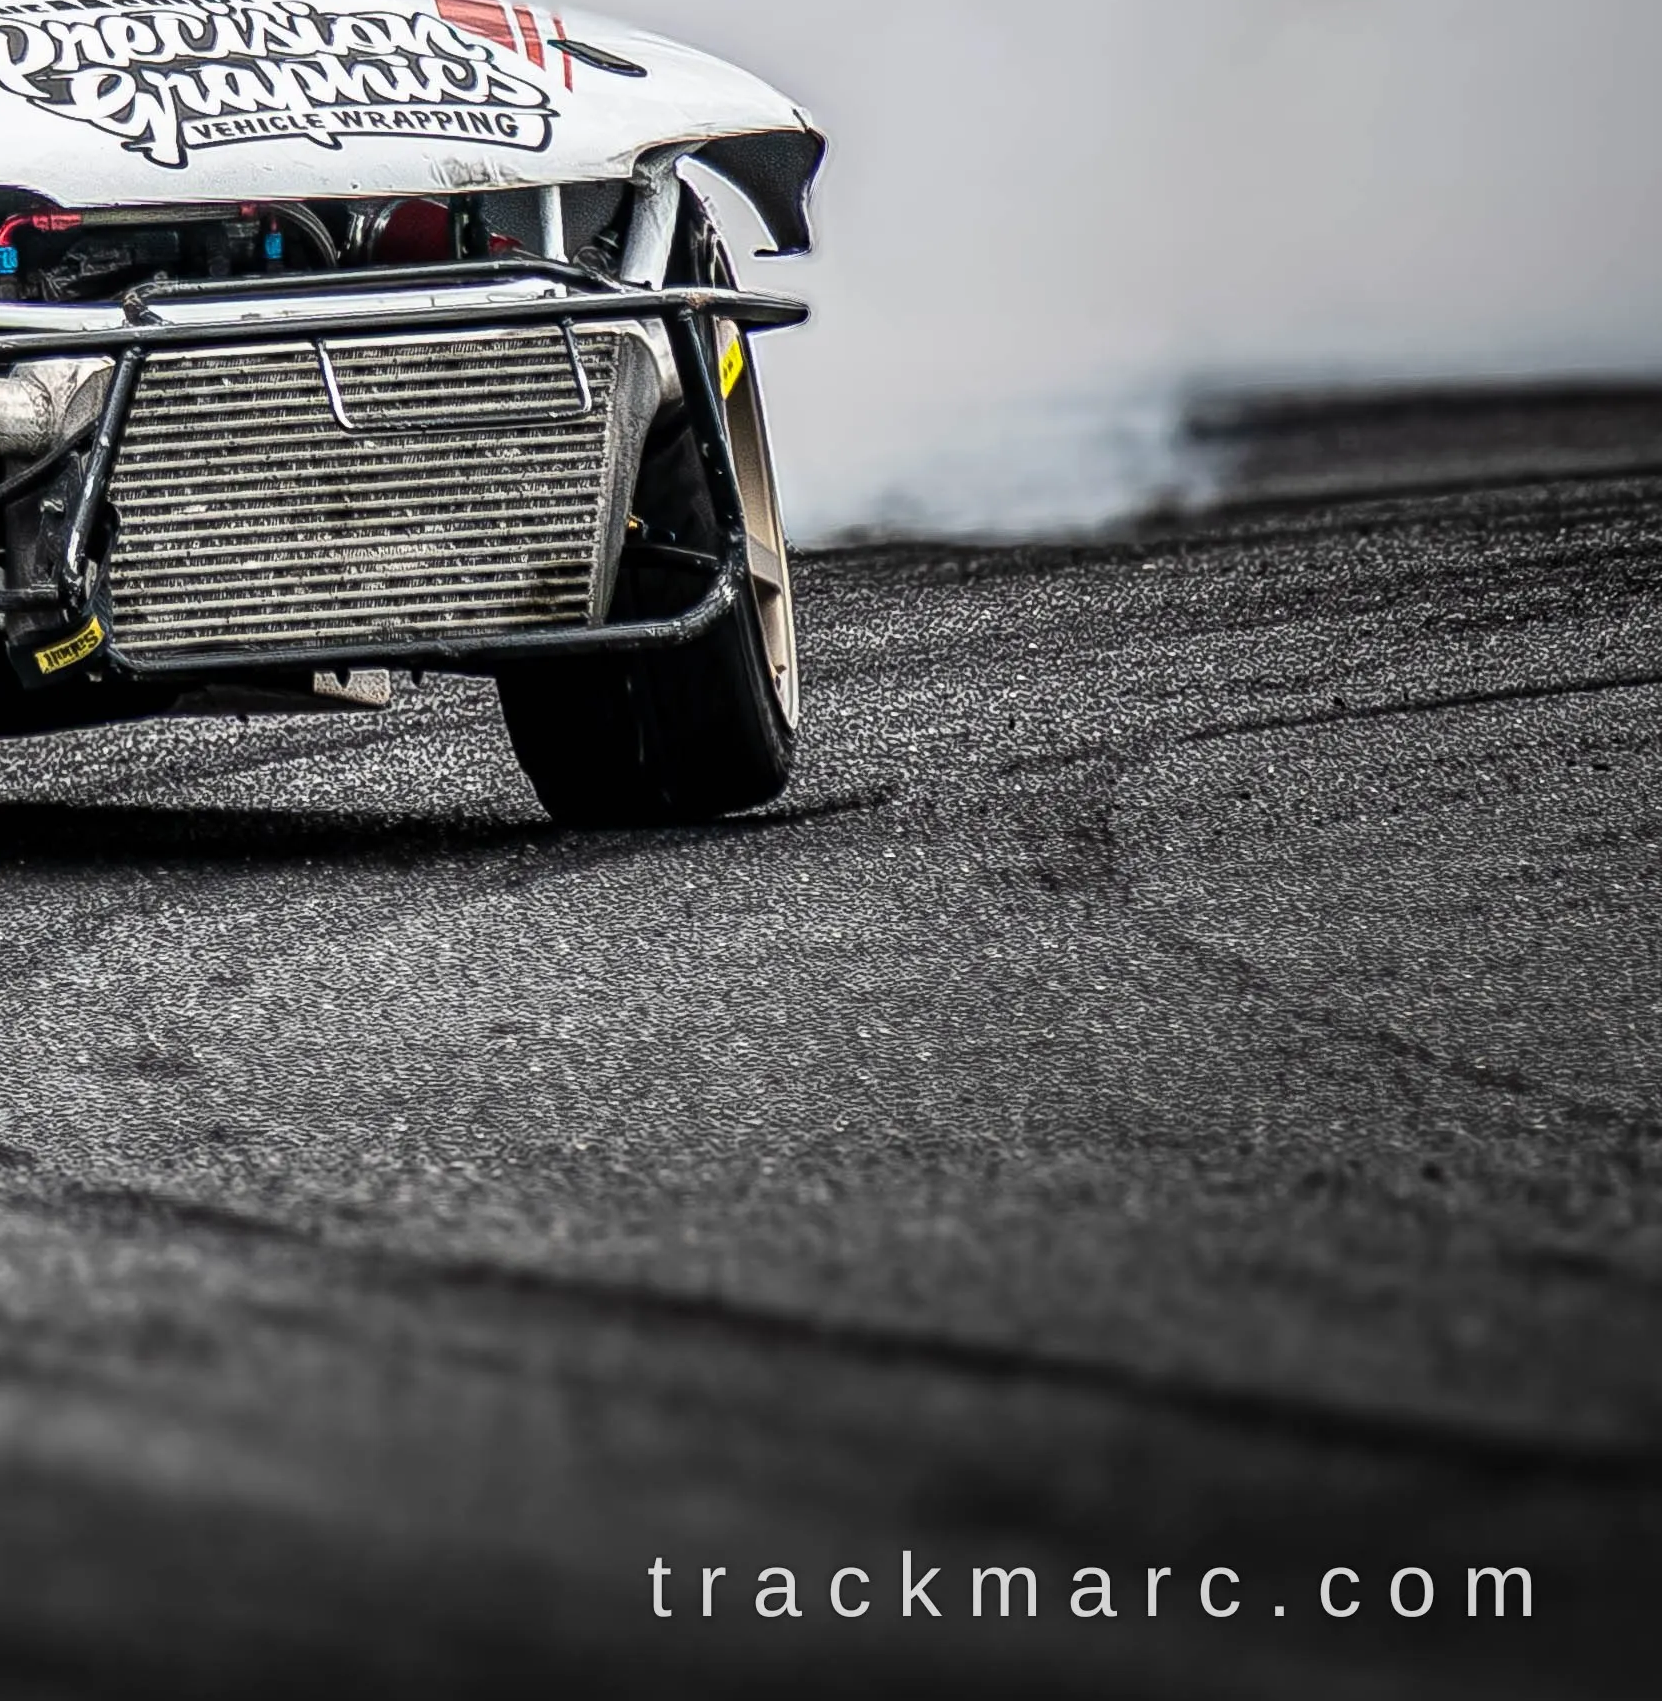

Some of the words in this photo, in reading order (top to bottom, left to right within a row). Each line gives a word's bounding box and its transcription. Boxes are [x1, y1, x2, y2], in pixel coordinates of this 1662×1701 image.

[62, 50, 549, 167] Graphics
[190, 113, 325, 140] VEHICLE
[330, 110, 519, 138] WRAPPING
